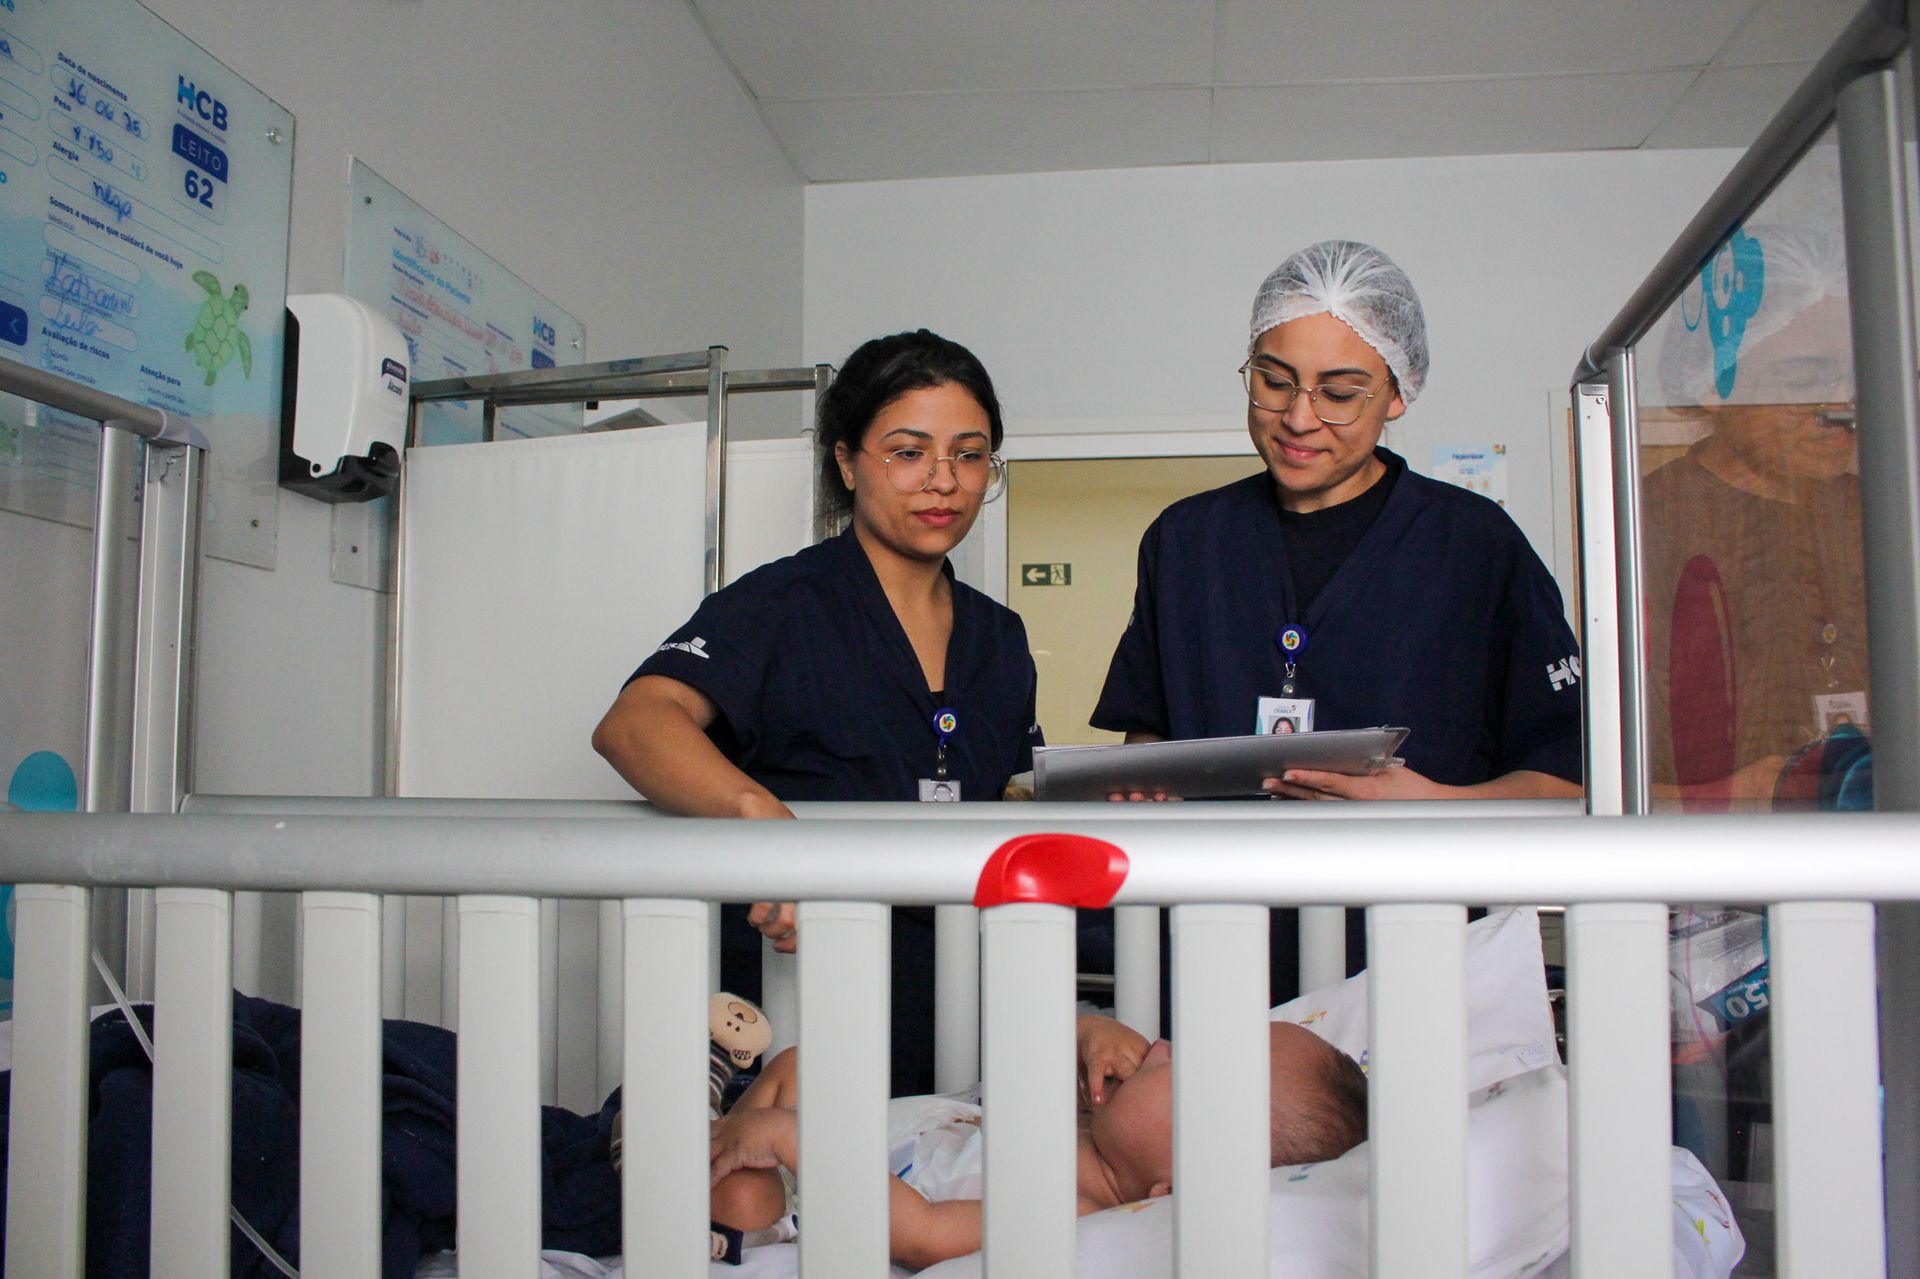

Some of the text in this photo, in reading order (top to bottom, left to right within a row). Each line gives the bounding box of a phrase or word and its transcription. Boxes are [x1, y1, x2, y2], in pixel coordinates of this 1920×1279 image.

[177, 74, 228, 131] HCB
[180, 134, 221, 171] LEITO
[185, 169, 214, 209] 62
[533, 315, 556, 346] HCB
